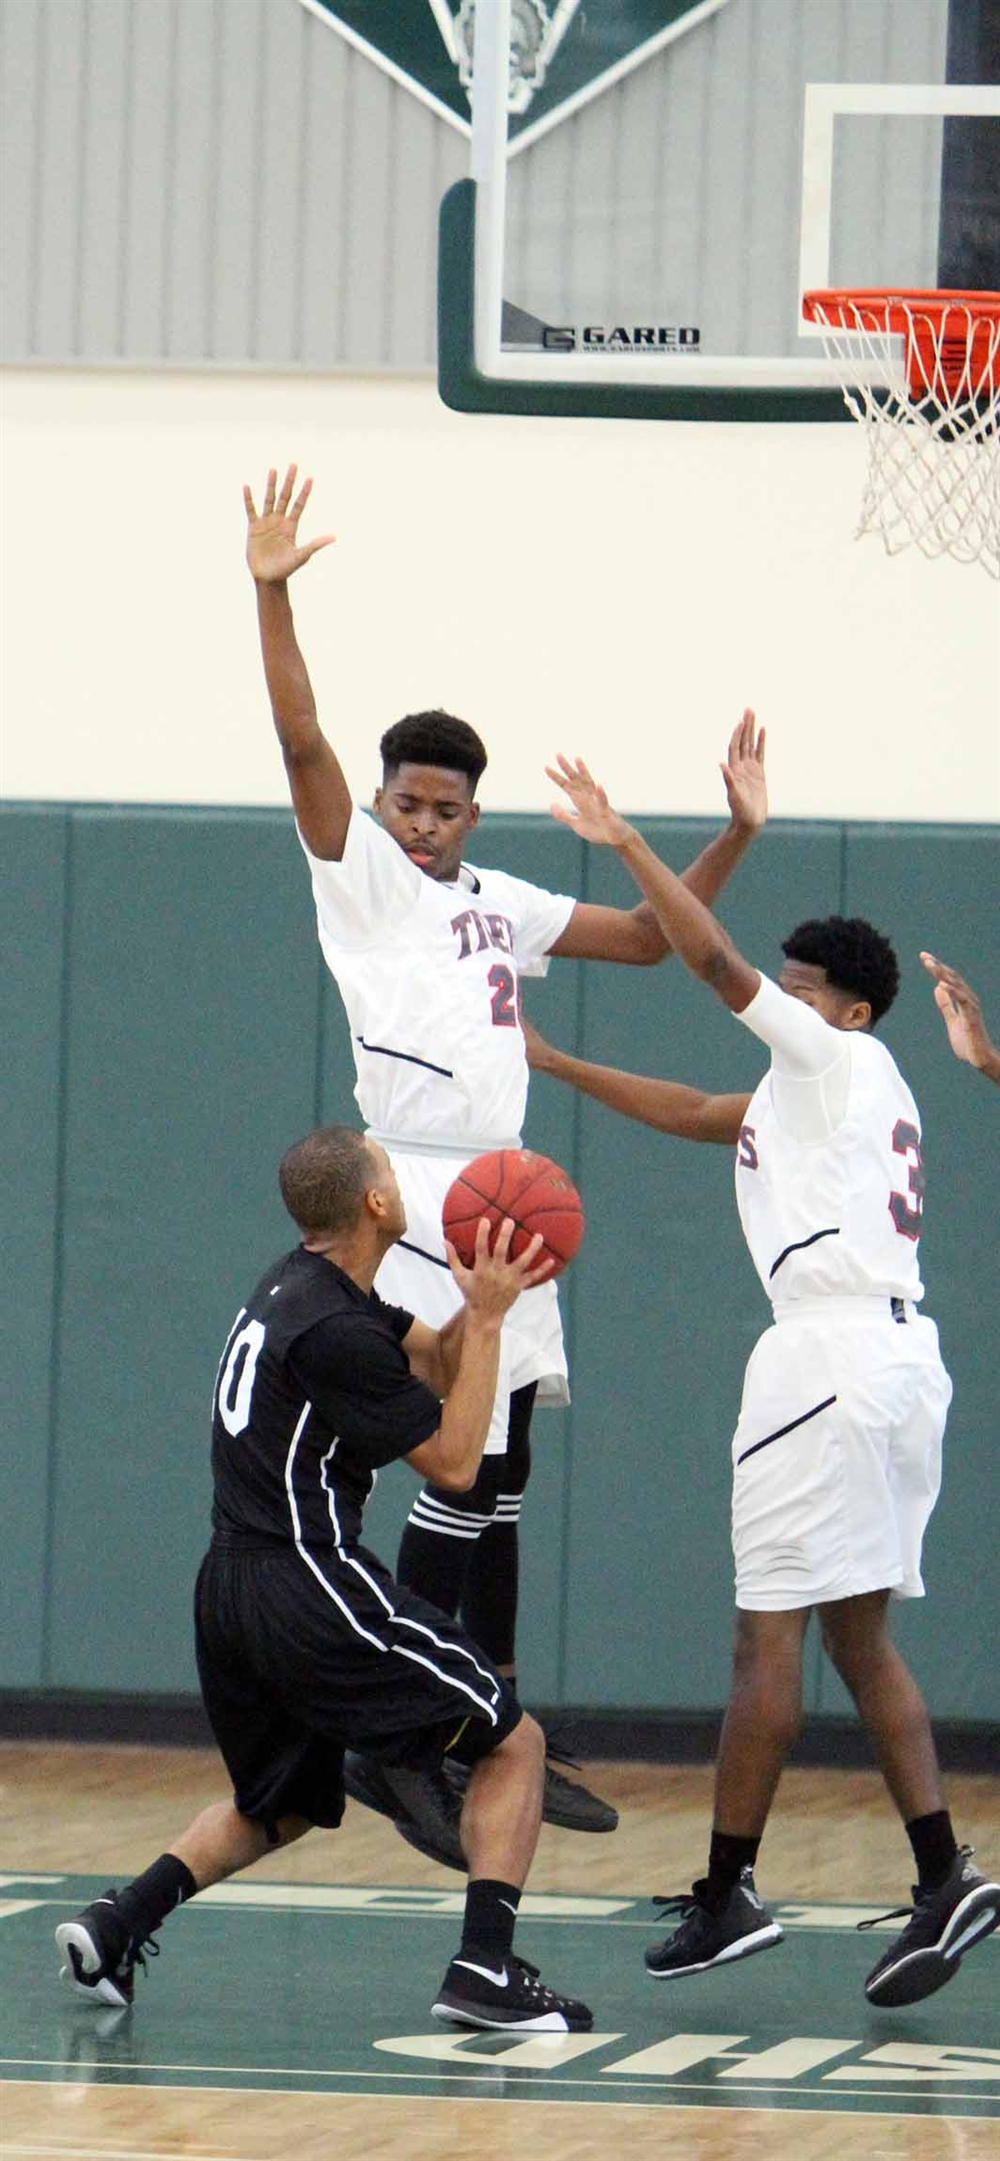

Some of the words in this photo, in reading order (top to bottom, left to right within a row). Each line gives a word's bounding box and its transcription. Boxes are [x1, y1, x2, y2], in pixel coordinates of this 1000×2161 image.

[582, 327, 700, 344] GARED
[487, 963, 523, 1028] 2
[888, 1118, 923, 1242] 3
